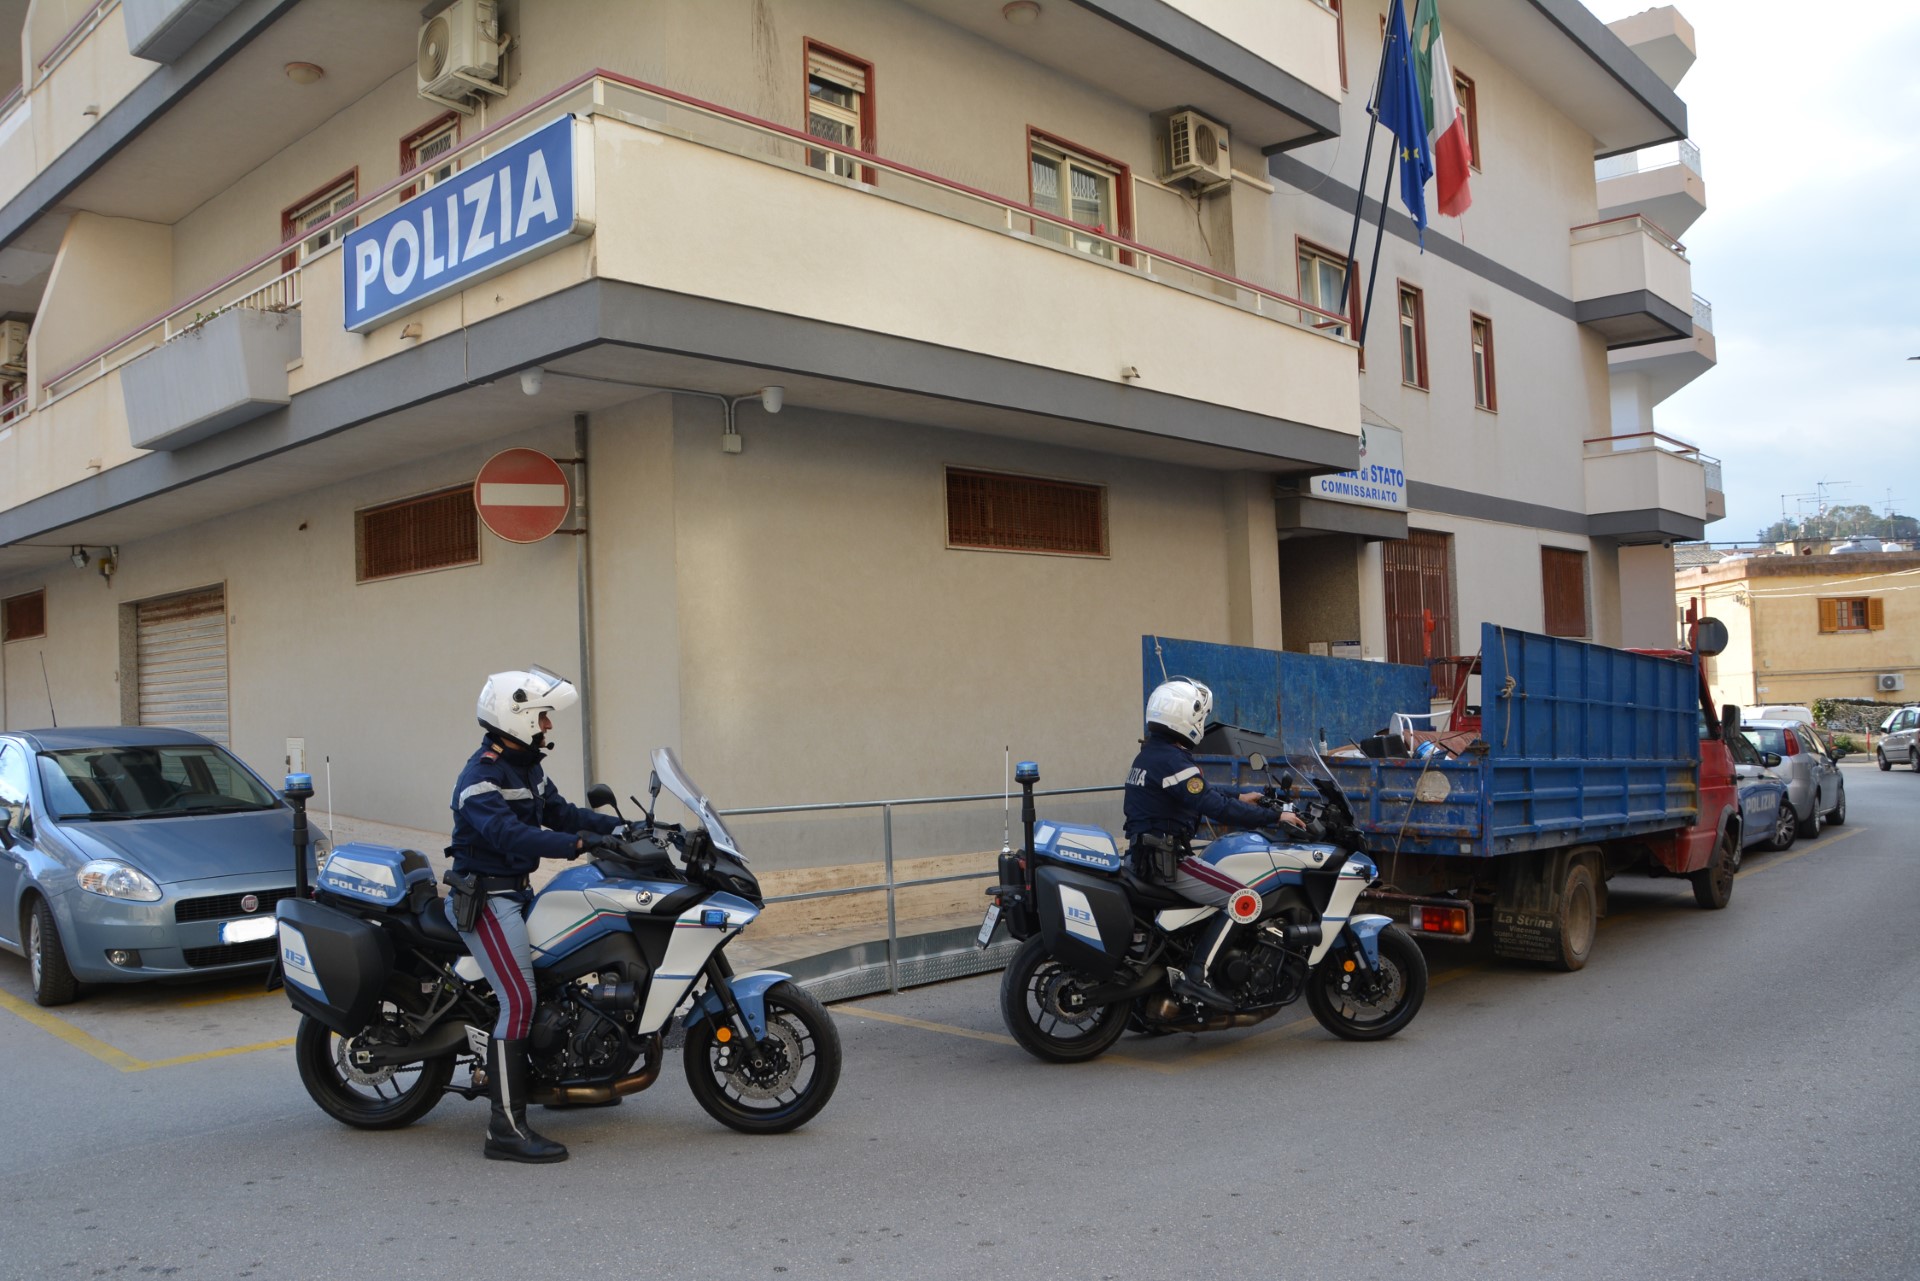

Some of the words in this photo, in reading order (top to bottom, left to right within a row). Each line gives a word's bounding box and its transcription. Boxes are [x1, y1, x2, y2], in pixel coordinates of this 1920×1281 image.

[354, 147, 559, 311] POLIZIA
[1361, 467, 1369, 481] di
[1371, 464, 1404, 487] STATO
[1321, 479, 1397, 503] COMMISSARIATO
[1745, 793, 1776, 814] POLIZIA
[1059, 849, 1110, 866] POLIZIA
[328, 877, 388, 899] POLIZIA
[1066, 906, 1091, 921] 113
[1497, 912, 1513, 924] La
[1517, 914, 1553, 928] Strina
[284, 947, 307, 967] 113
